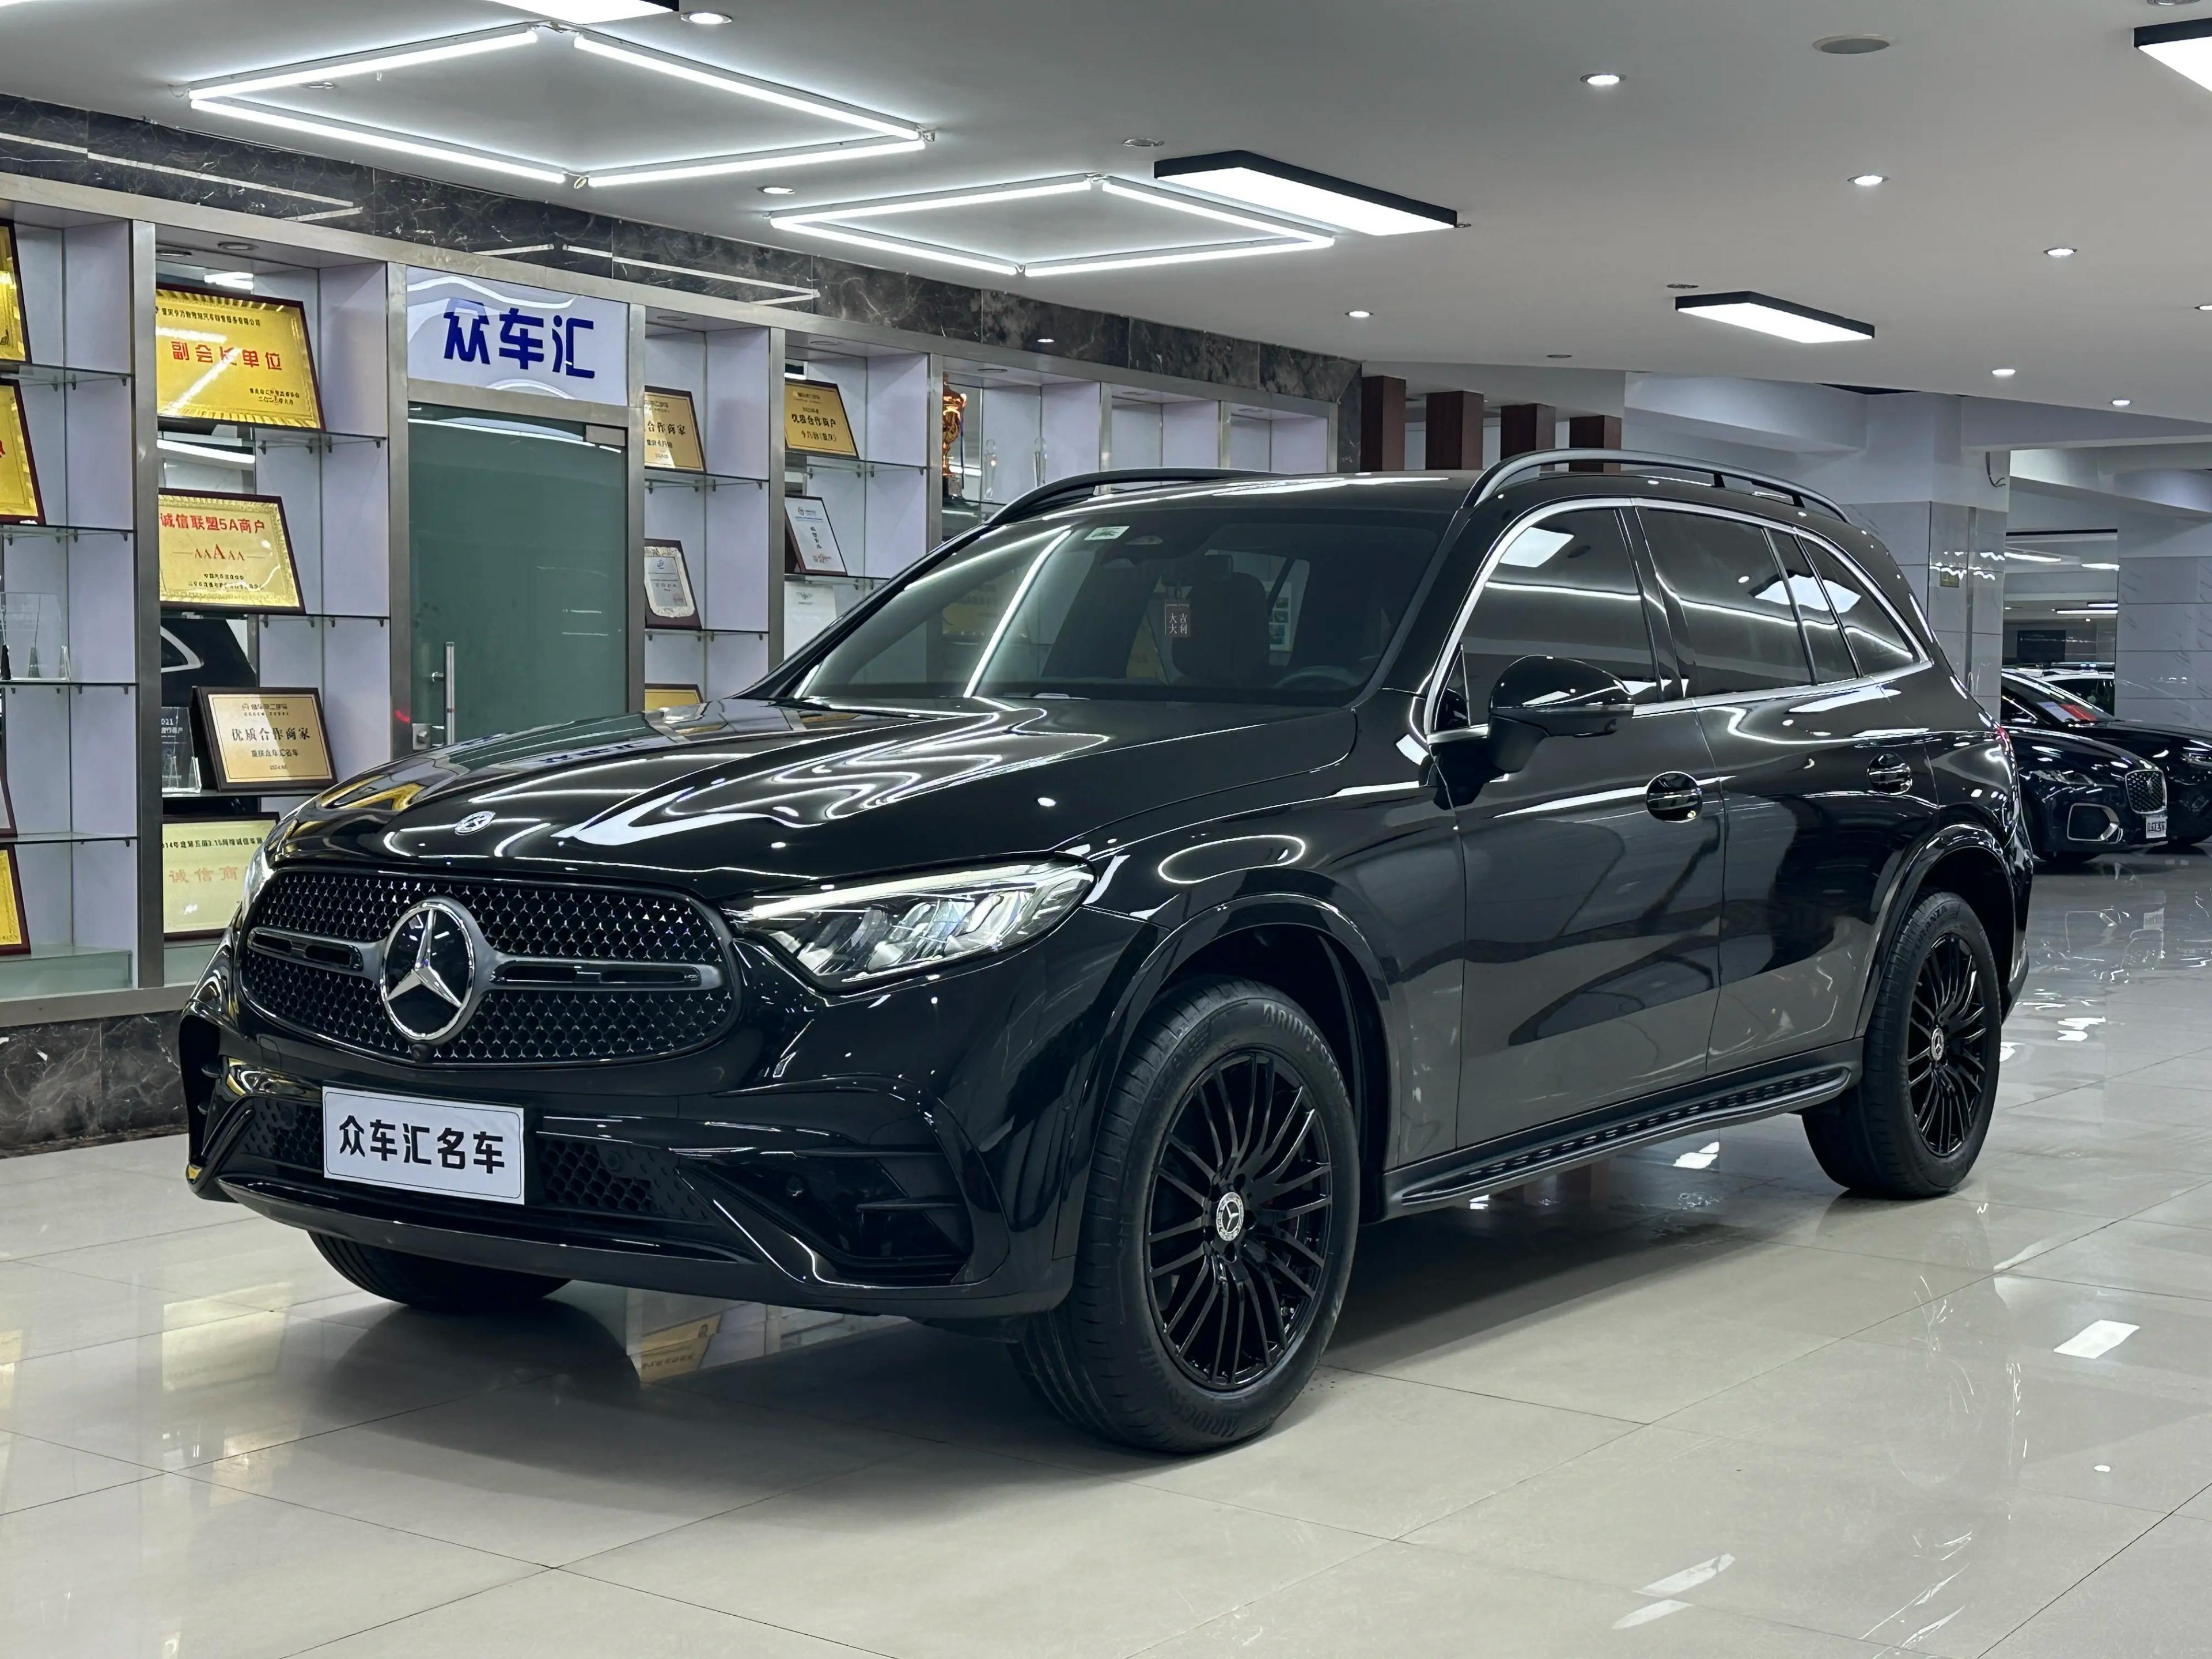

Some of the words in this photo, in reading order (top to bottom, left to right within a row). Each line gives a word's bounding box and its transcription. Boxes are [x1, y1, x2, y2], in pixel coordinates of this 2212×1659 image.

[444, 298, 595, 378] 众车汇
[160, 513, 265, 533] 诚信联盟5A商户
[232, 727, 310, 741] 优质合作商家
[339, 1115, 505, 1174] 众车汇名车
